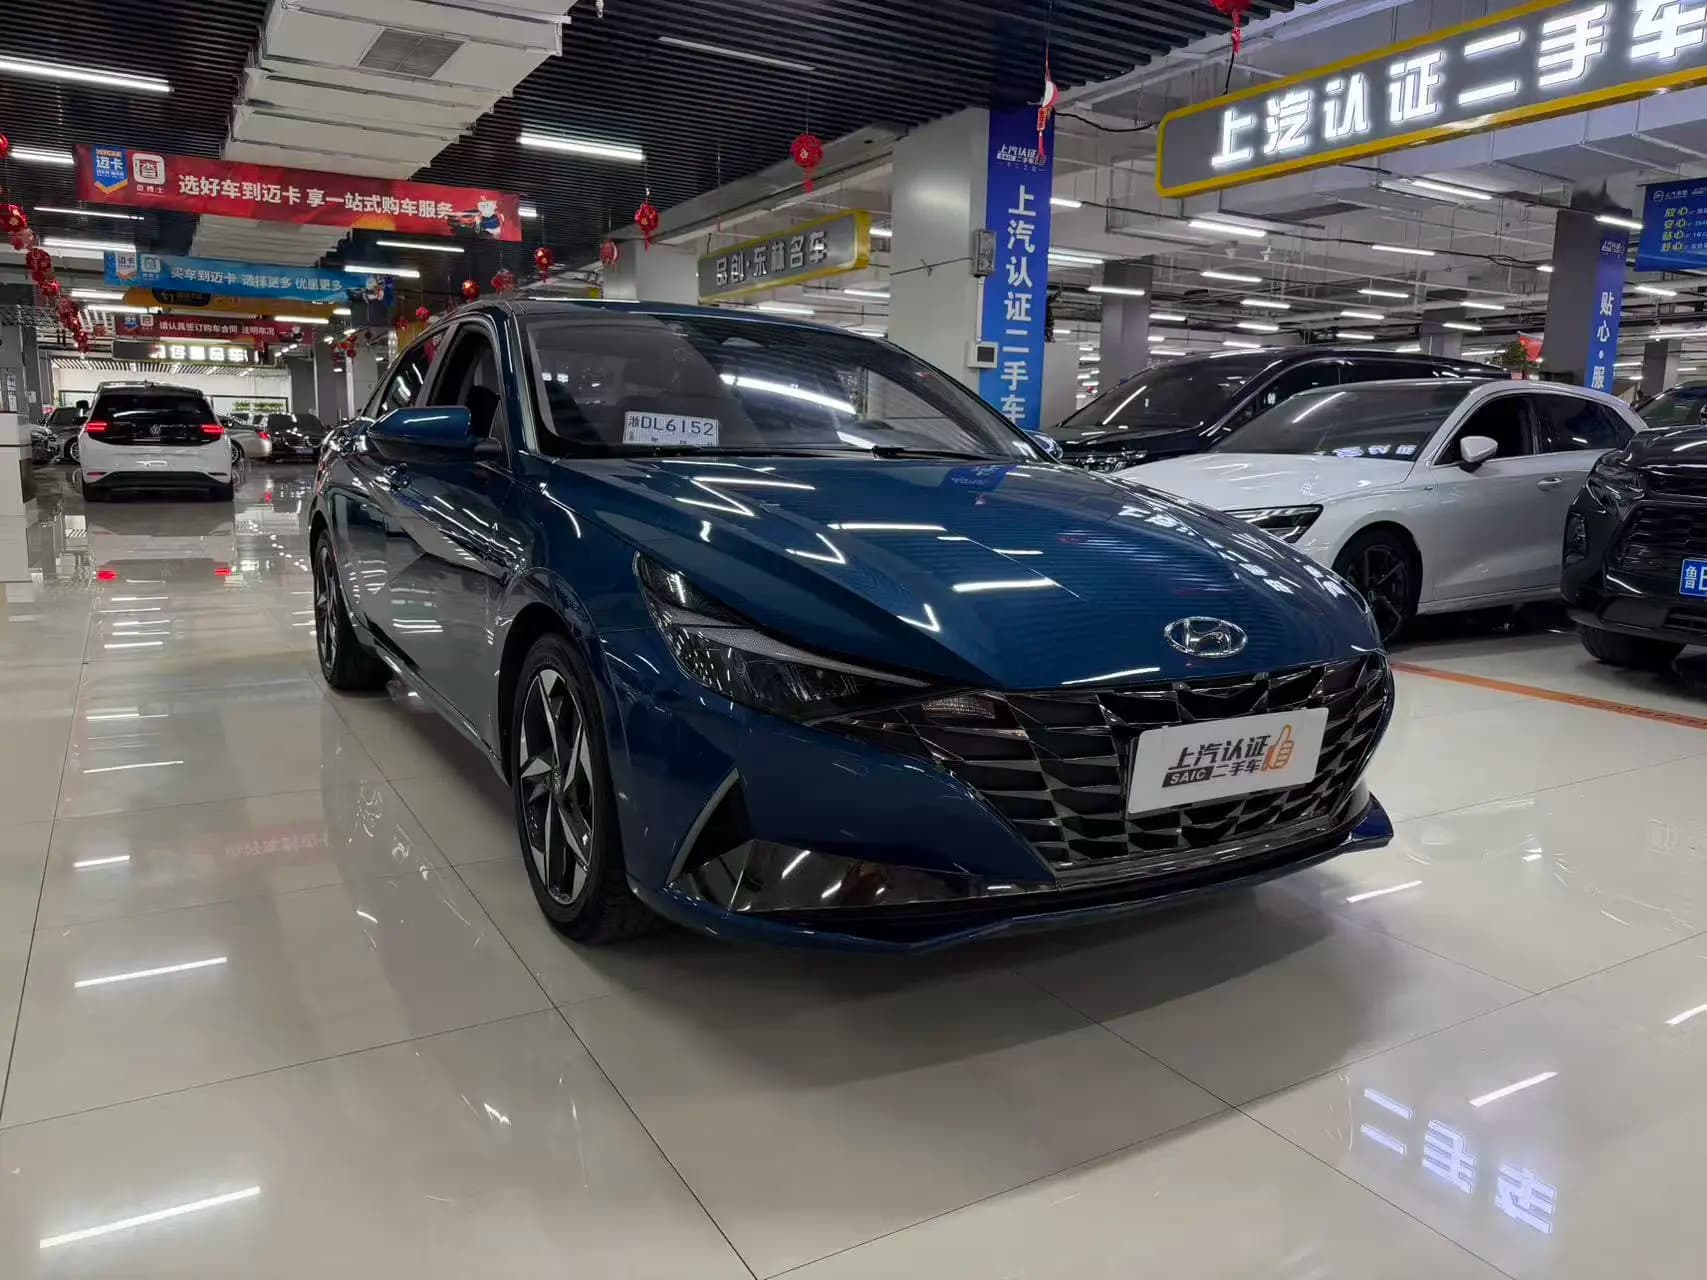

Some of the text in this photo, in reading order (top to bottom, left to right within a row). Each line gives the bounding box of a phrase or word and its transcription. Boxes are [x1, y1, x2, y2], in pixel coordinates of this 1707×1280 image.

[1212, 0, 1707, 167] 上汽认证二手车
[96, 155, 124, 171] 迈卡
[178, 174, 453, 220] 选好车到迈卡 享一站式购车服务
[170, 267, 237, 285] 买车到迈卡
[1000, 184, 1036, 424] 上汽认证二手车
[1168, 735, 1272, 770] 上汽认证
[1169, 759, 1264, 786] SAIC 二手车
